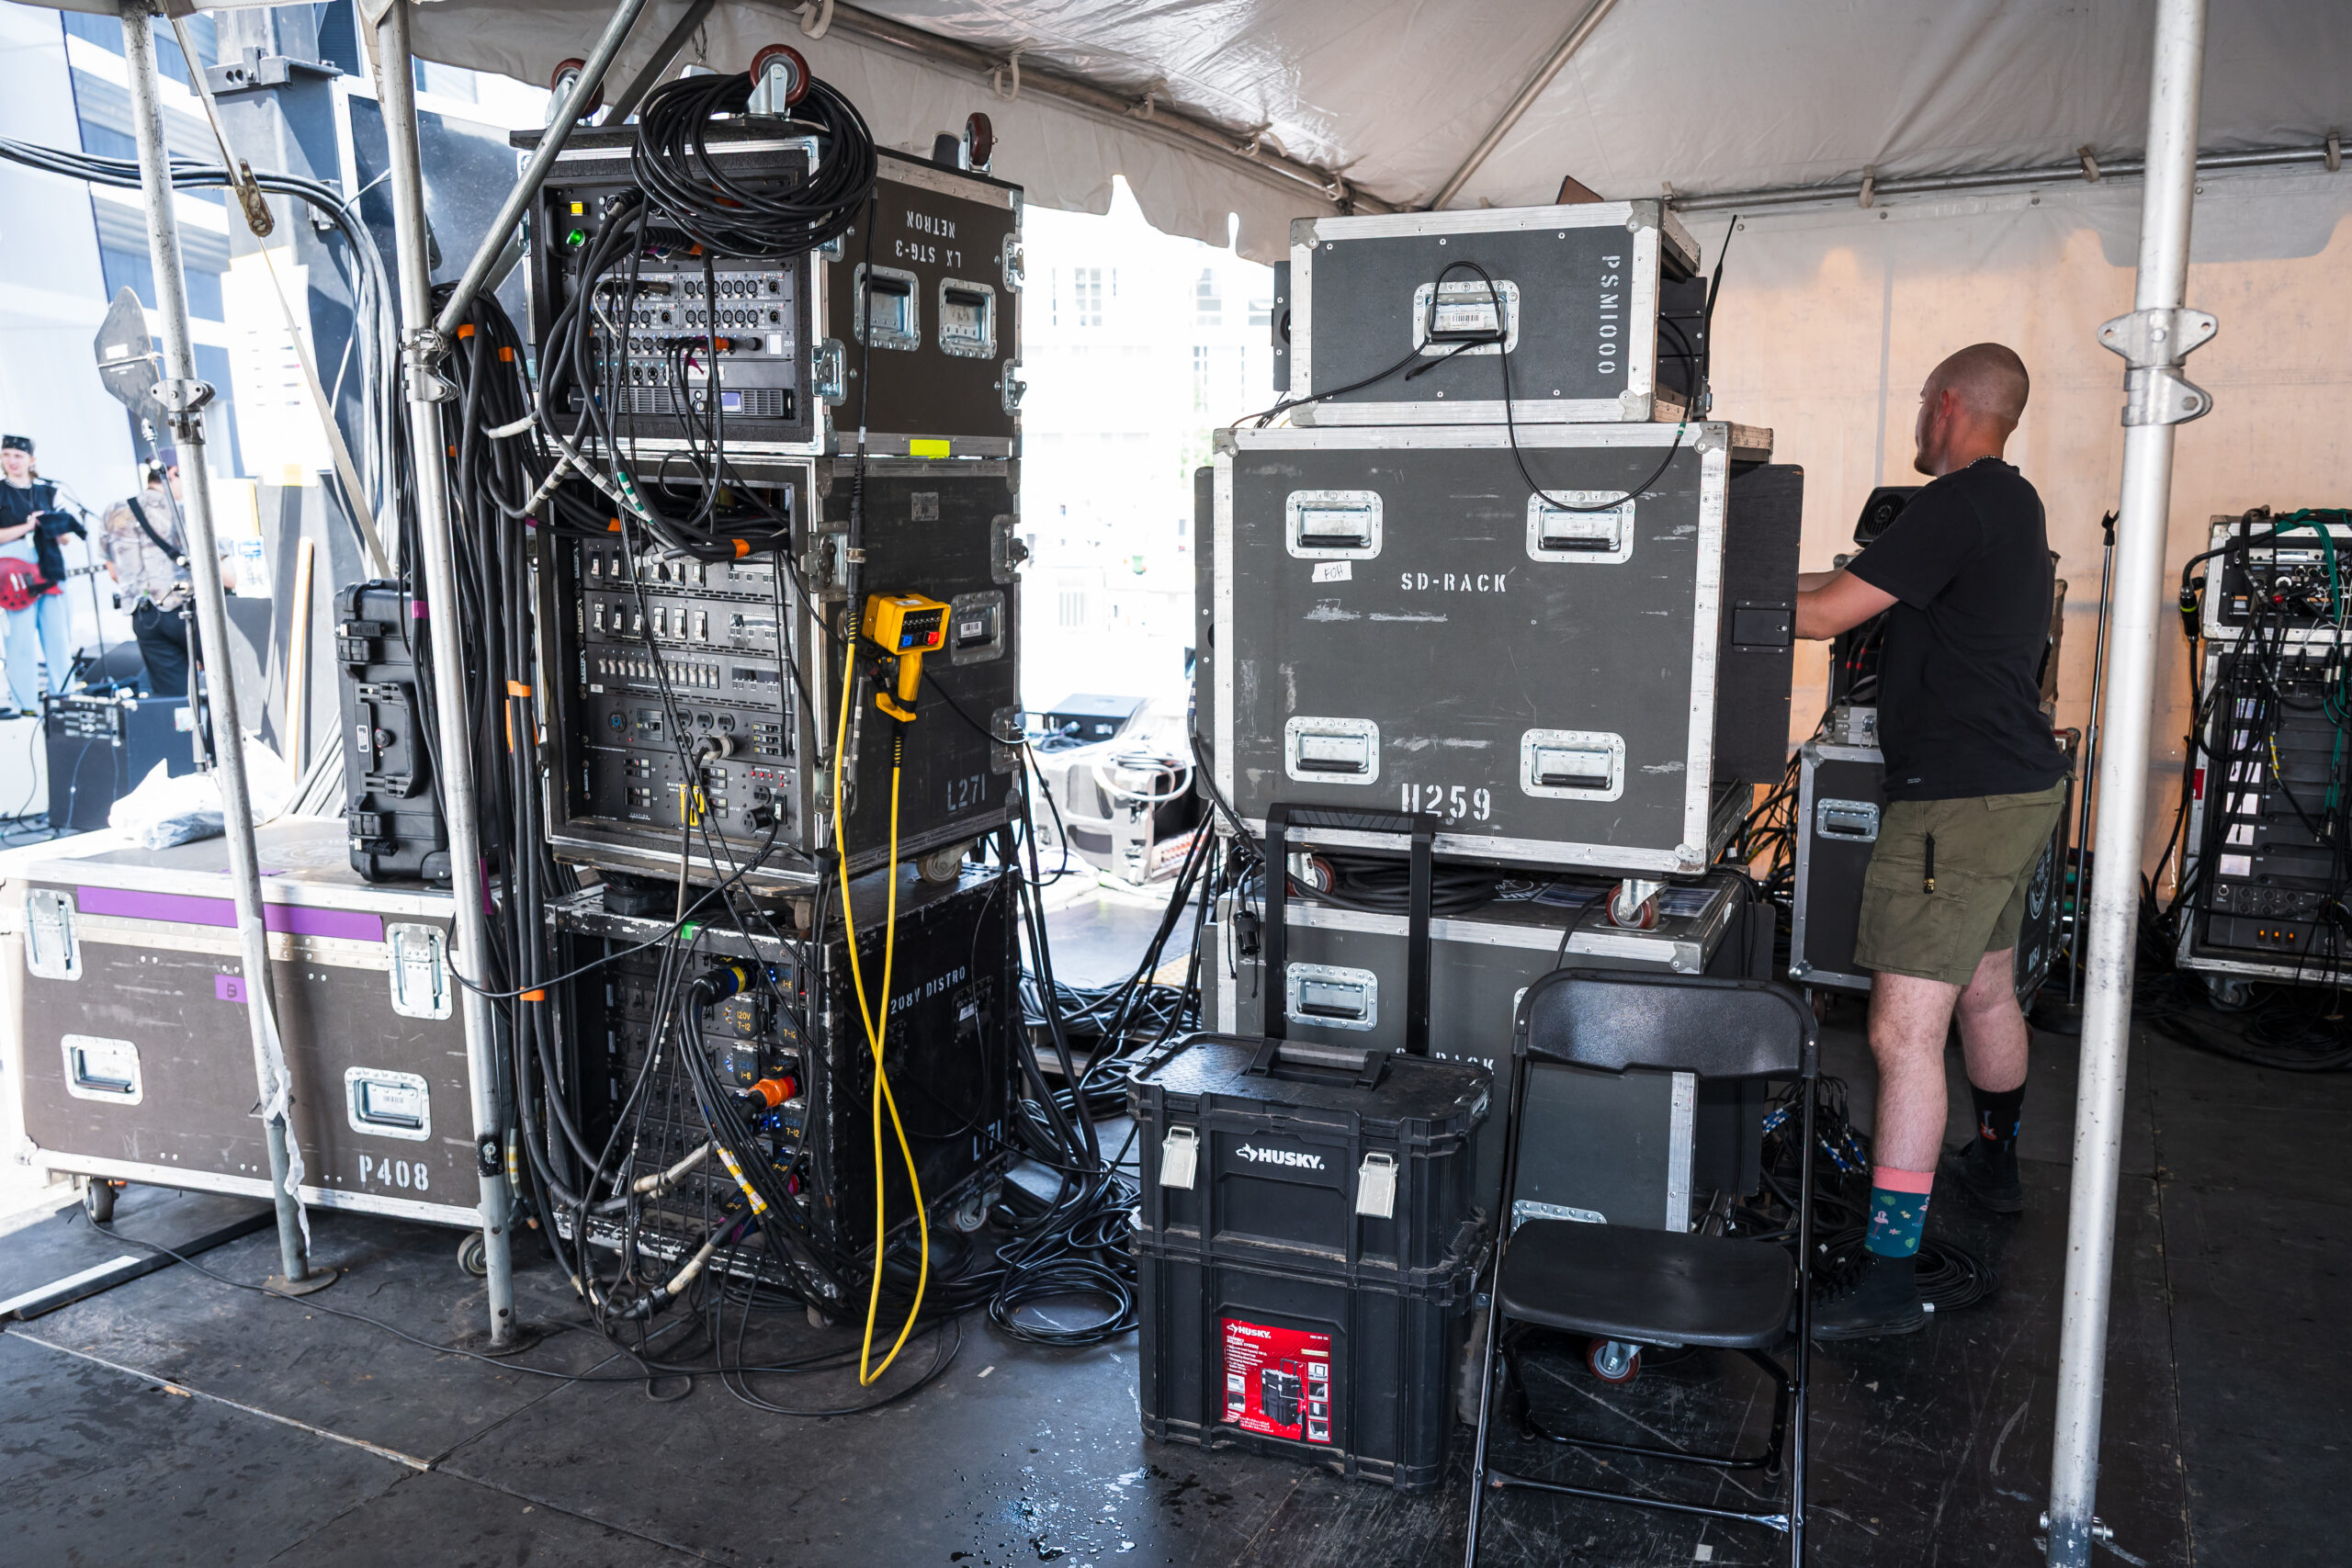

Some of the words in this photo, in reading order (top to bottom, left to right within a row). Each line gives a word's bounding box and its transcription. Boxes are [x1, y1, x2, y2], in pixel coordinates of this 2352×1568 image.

[906, 209, 956, 240] NETRON
[895, 240, 936, 263] STG-3
[946, 251, 962, 268] LX
[1324, 564, 1344, 581] FOH
[1400, 571, 1507, 592] SD-RACK
[947, 773, 986, 811] L271
[1401, 783, 1491, 821] H259
[889, 987, 921, 1015] 208V
[925, 965, 966, 998] DISTRO
[737, 1010, 751, 1021] 120V
[737, 1021, 751, 1032] 7-12
[786, 1127, 800, 1138] 7-12
[974, 1119, 1001, 1161] L71
[1258, 1147, 1321, 1169] HUSKY
[358, 1154, 429, 1191] P408
[1238, 1325, 1271, 1339] HUSKY
